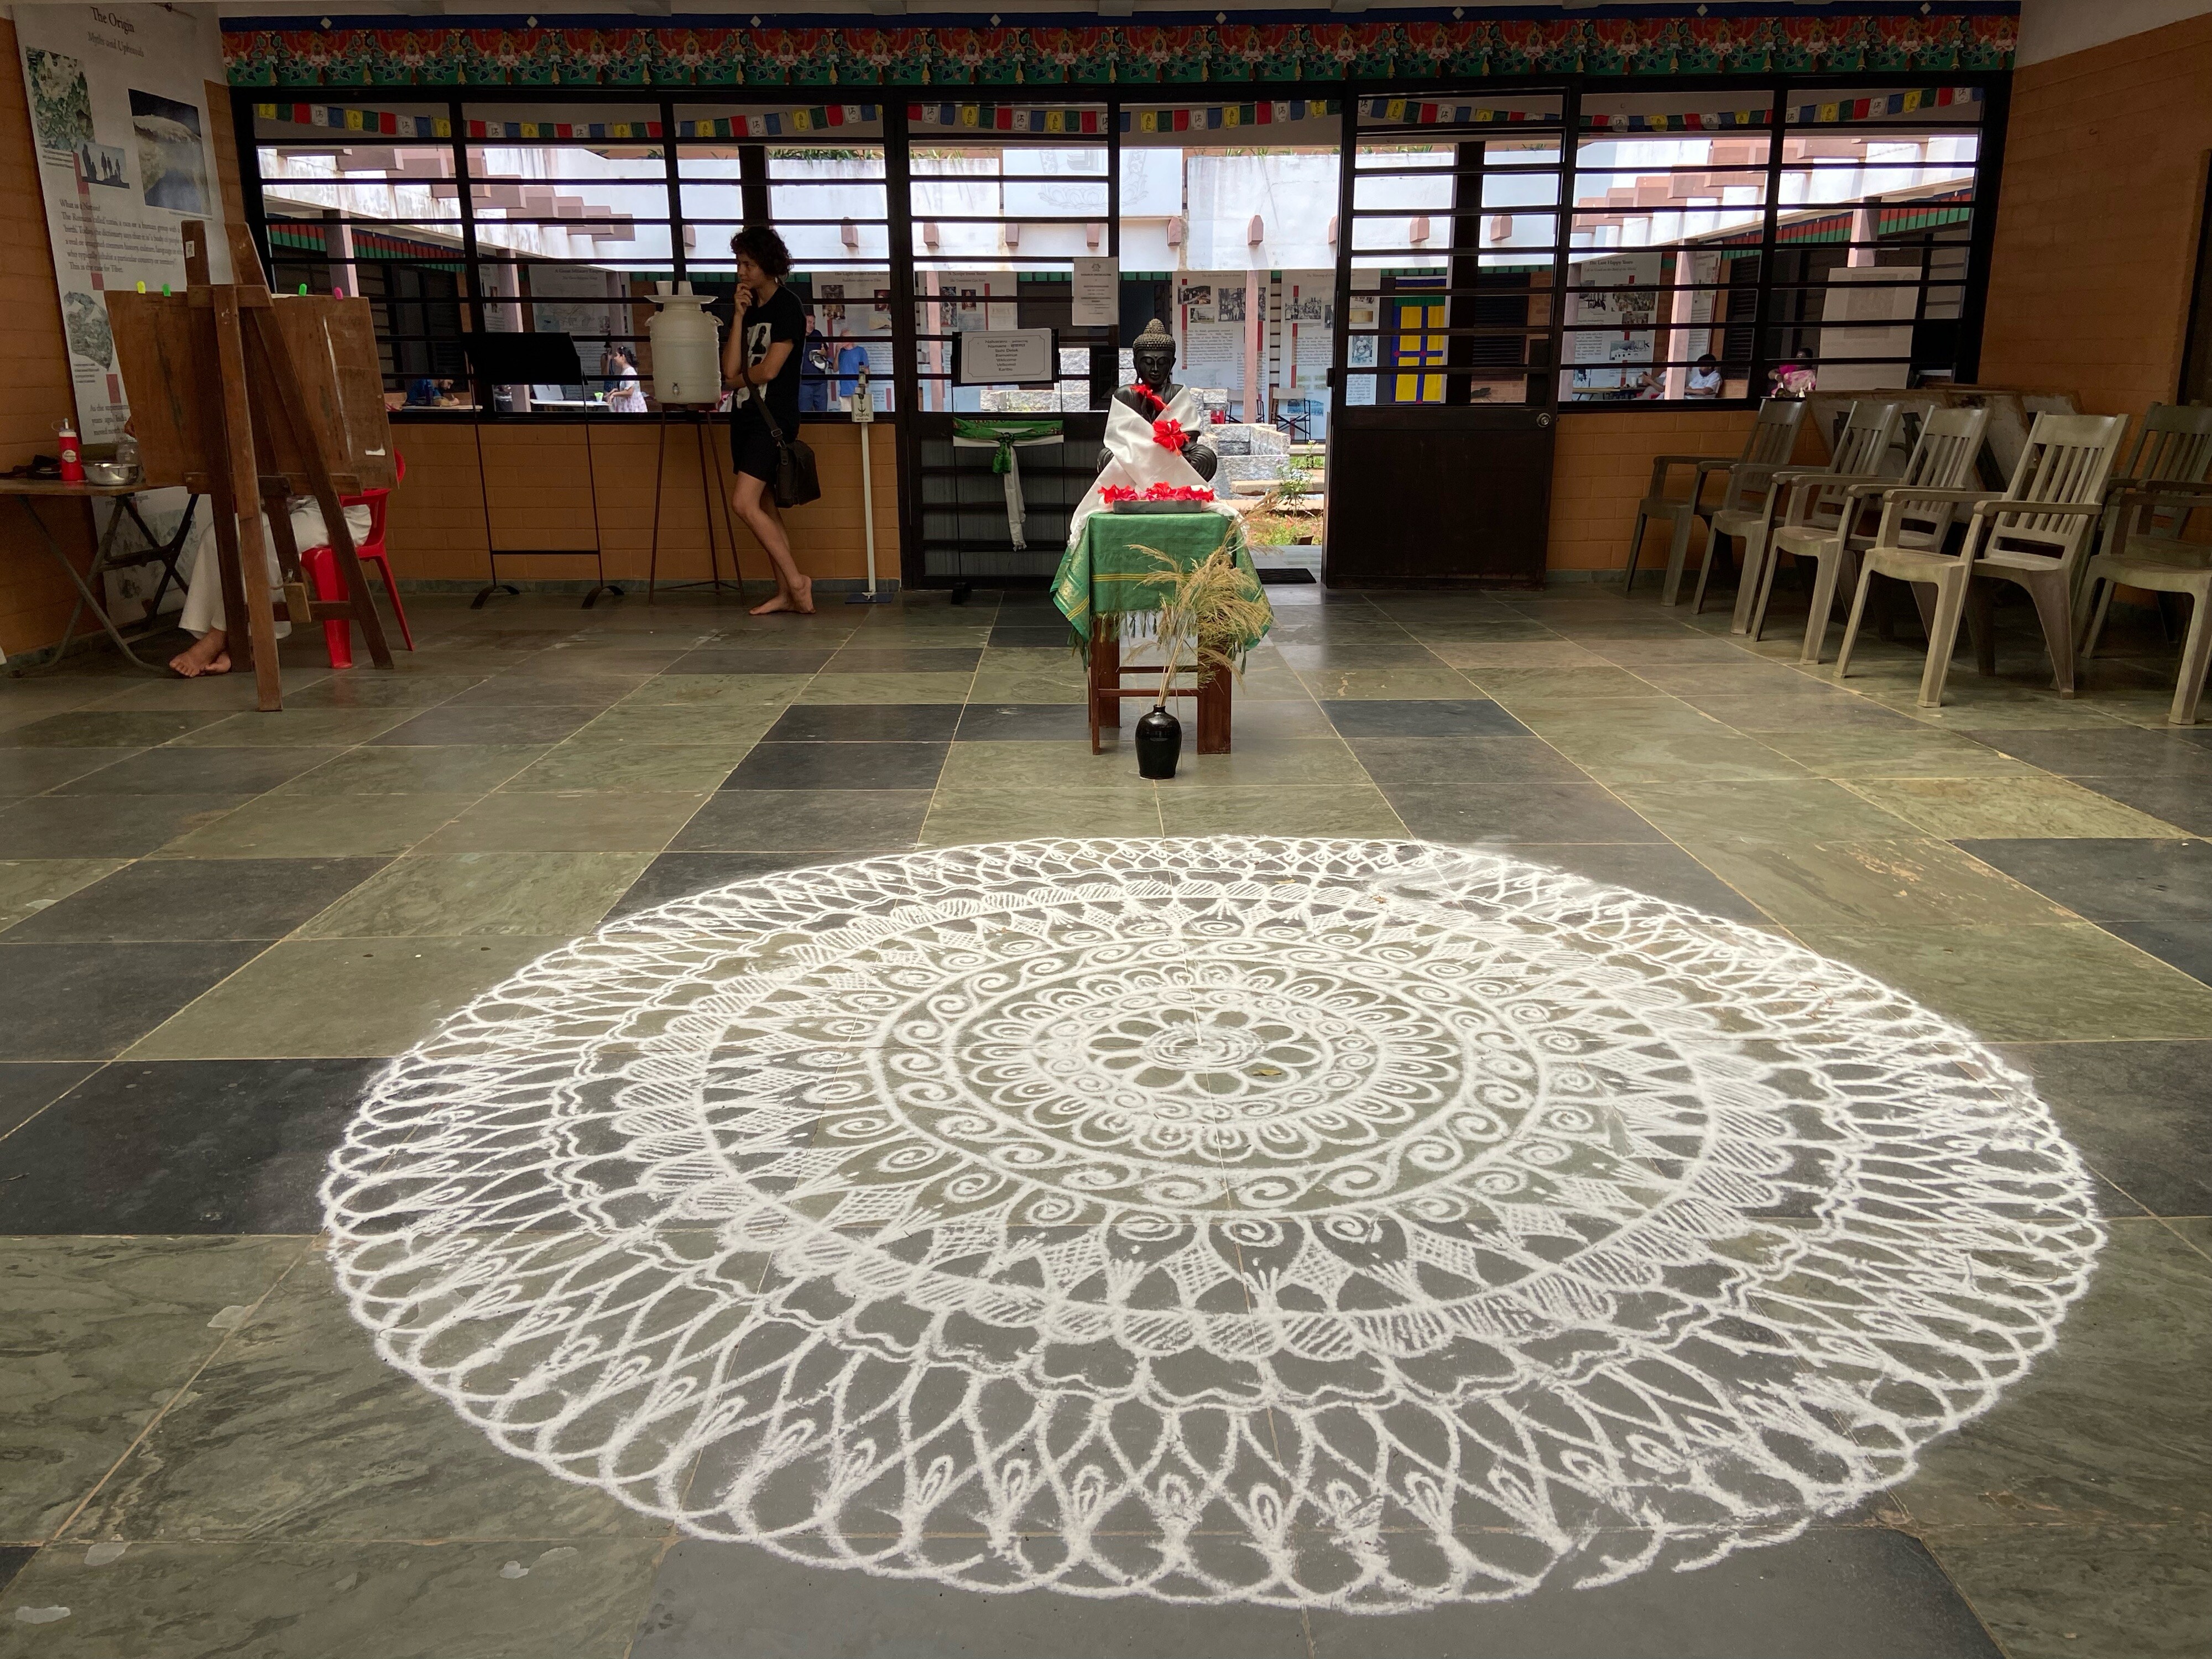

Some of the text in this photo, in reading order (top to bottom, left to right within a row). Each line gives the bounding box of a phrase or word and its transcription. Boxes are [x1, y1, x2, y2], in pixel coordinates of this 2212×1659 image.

[90, 6, 135, 35] The Origin
[61, 212, 71, 220] The
